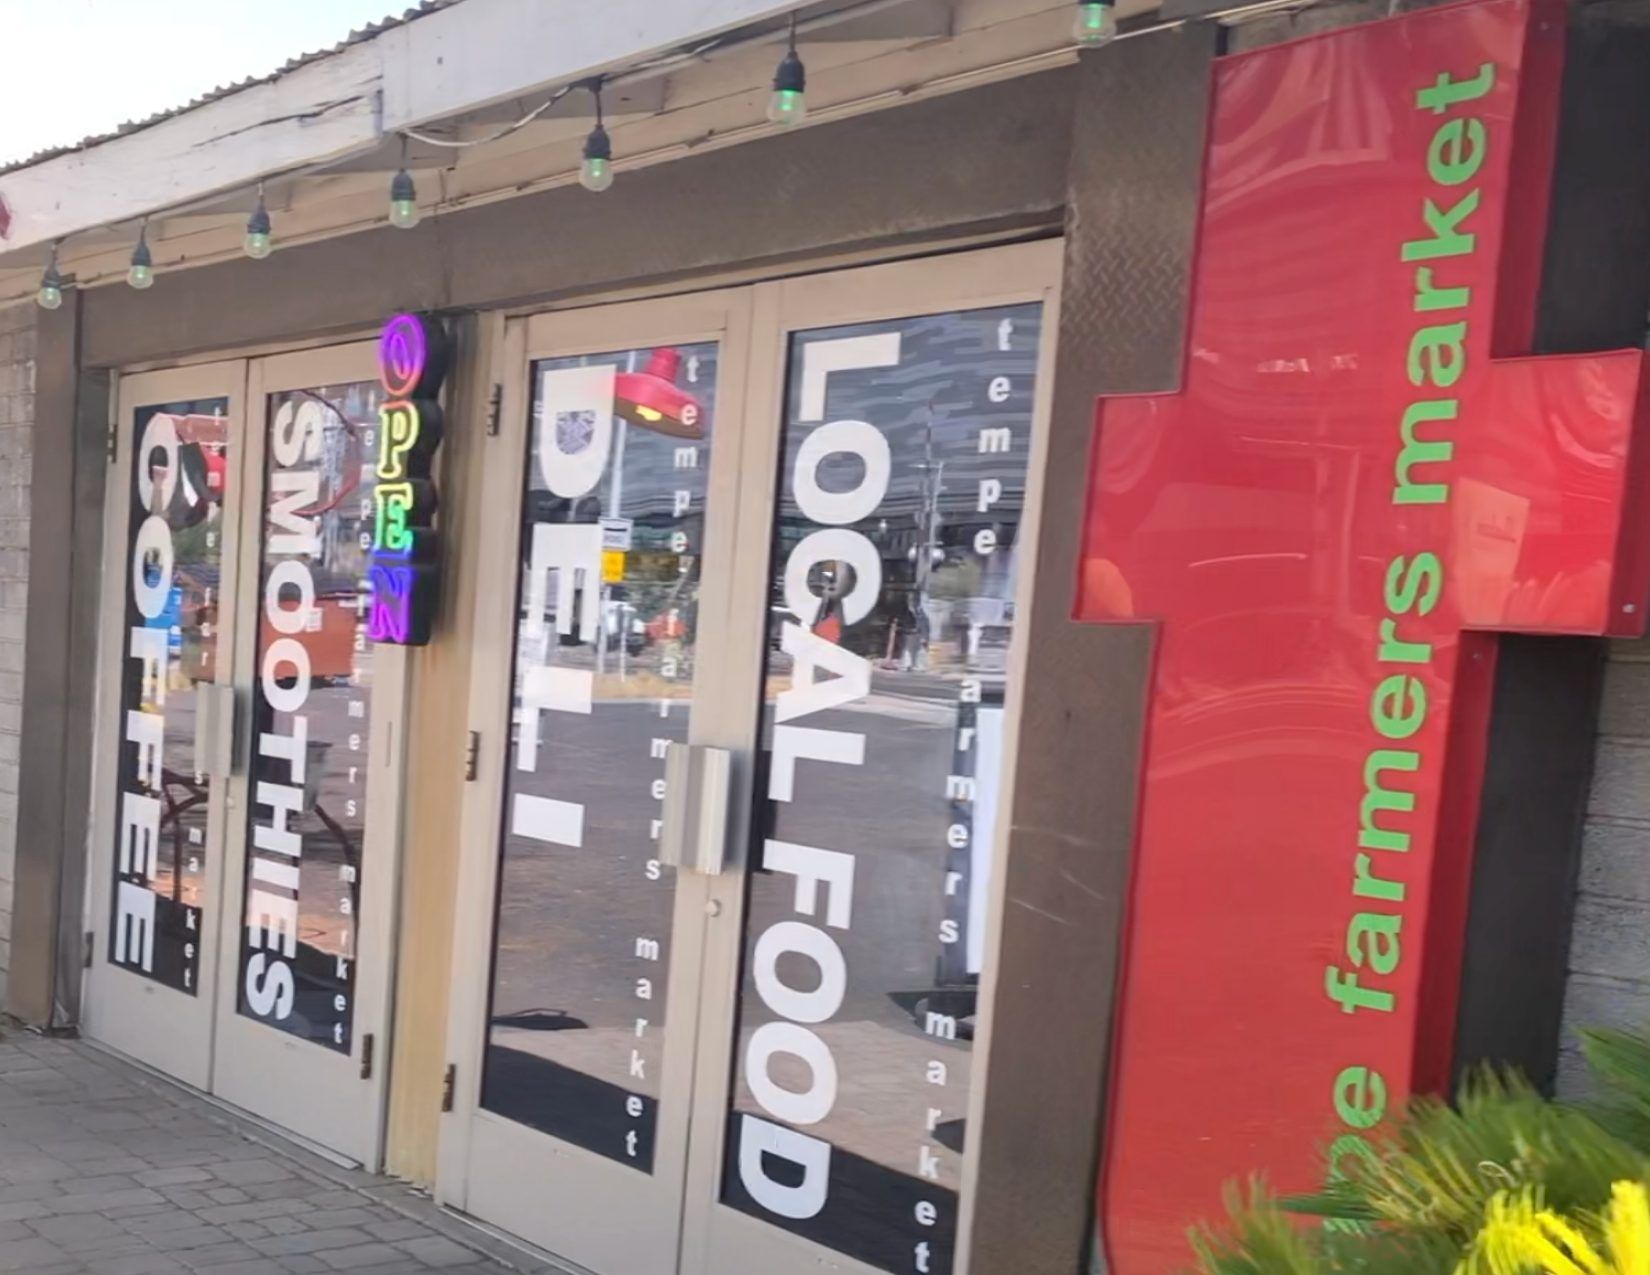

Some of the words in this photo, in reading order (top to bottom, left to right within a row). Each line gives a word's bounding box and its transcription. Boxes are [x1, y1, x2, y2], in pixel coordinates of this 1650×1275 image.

[369, 313, 426, 643] OPEN
[671, 356, 699, 553] tempe
[767, 332, 901, 802] LOCAL
[974, 318, 1013, 554] tempe
[1324, 551, 1443, 1014] farmers
[1392, 63, 1495, 504] market
[115, 412, 179, 973] COFFEE
[246, 400, 323, 1020] SMOOTHIES
[511, 364, 617, 848] DELI
[184, 828, 203, 987] market
[939, 622, 983, 944] farmers
[334, 864, 356, 1044] market
[625, 935, 659, 1156] market
[740, 838, 855, 1219] FOOD
[914, 1009, 957, 1274] market
